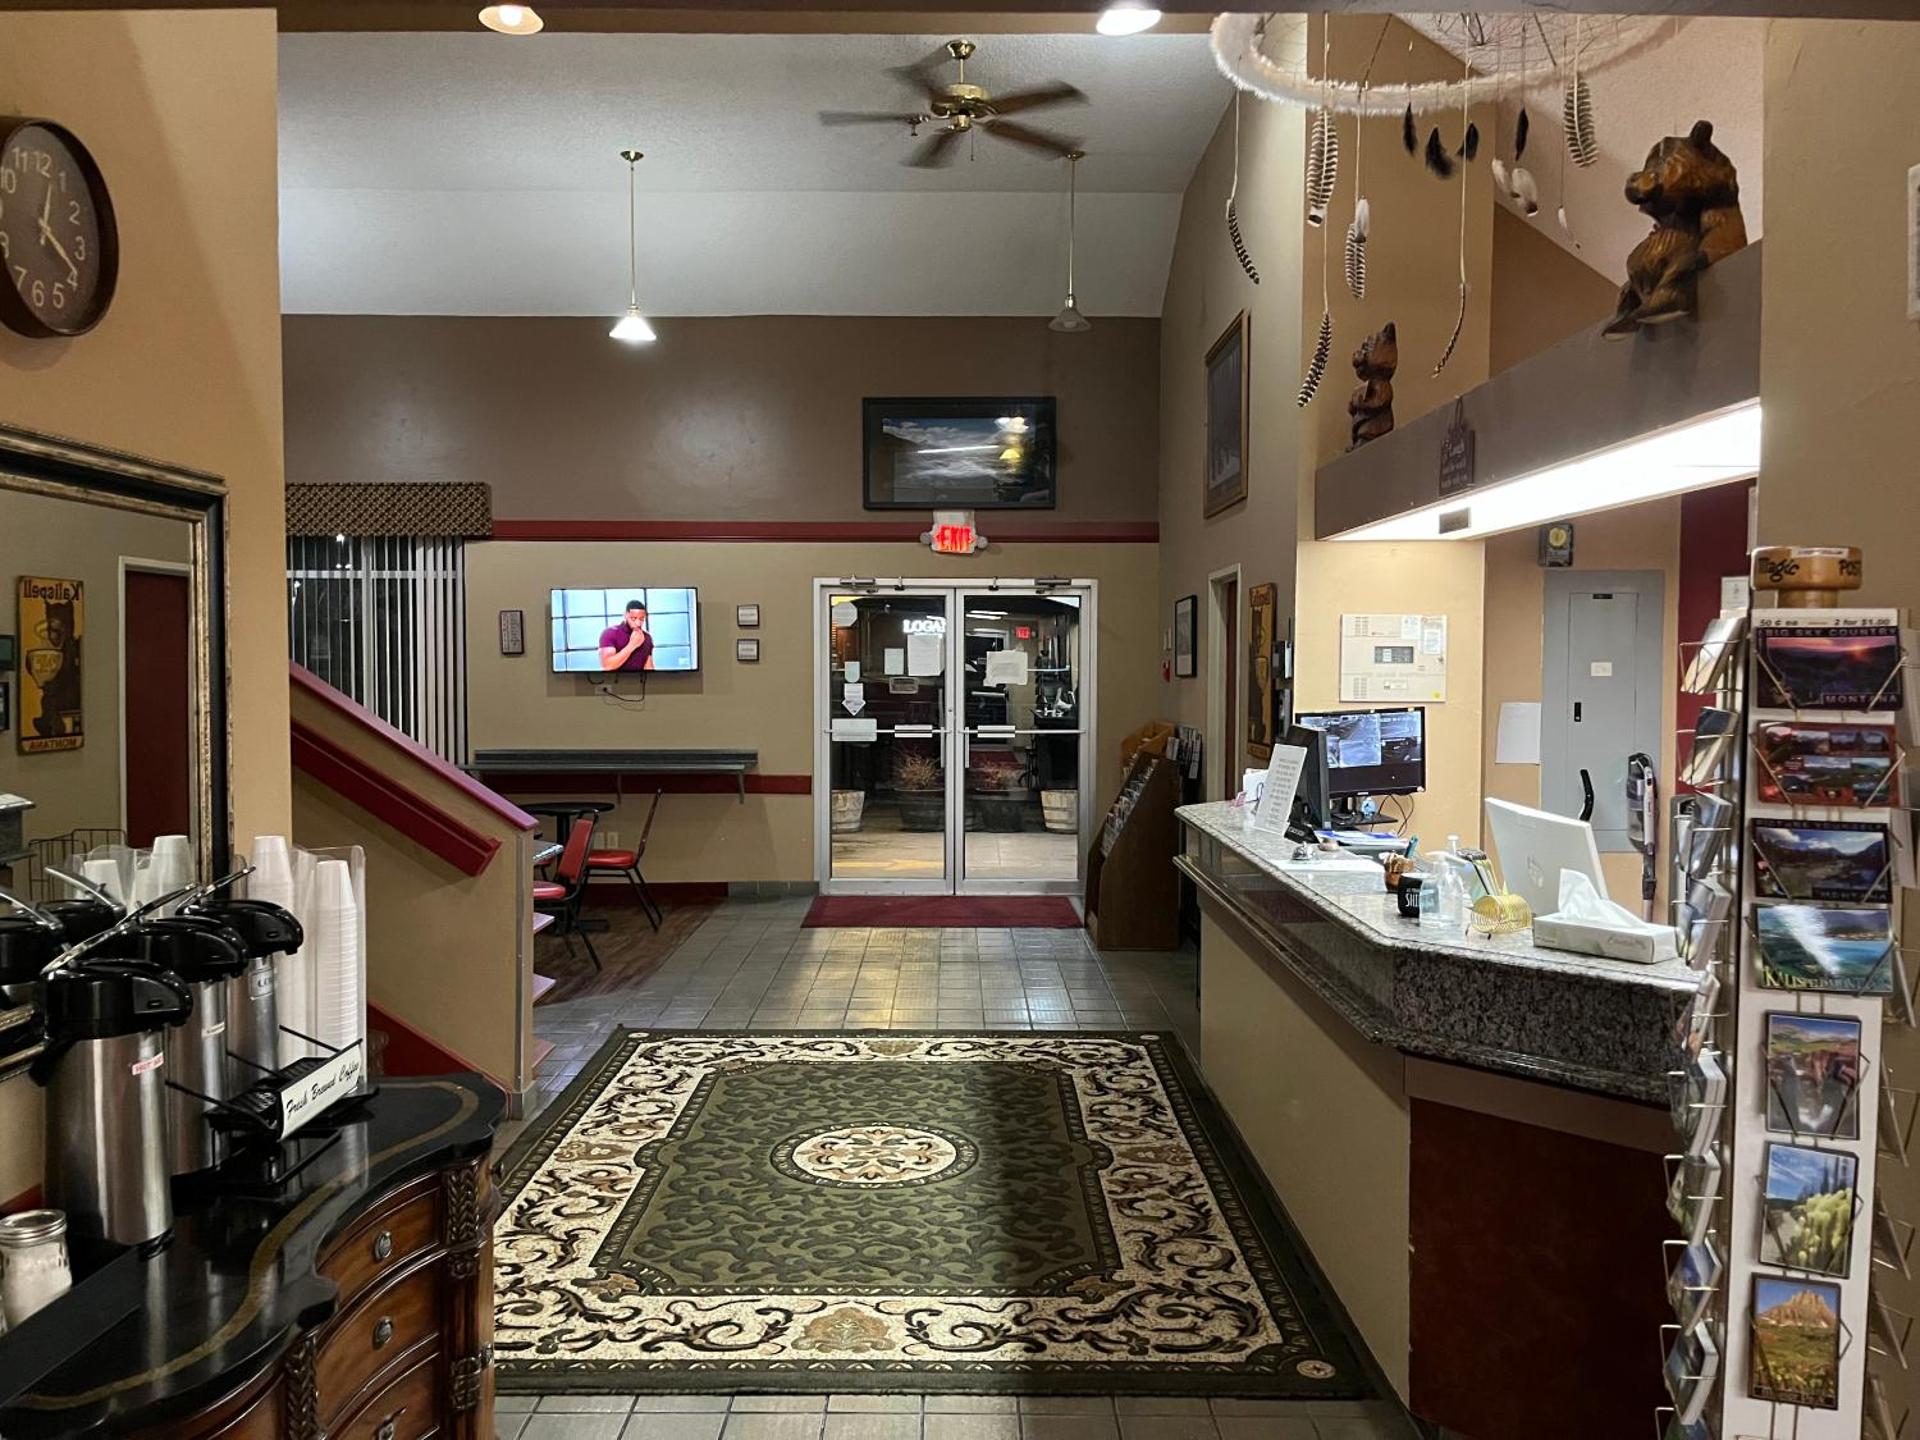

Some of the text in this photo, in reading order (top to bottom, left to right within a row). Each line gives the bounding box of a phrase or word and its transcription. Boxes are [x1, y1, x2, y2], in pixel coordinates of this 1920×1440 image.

[12, 147, 28, 173] 11
[33, 151, 51, 177] 12
[59, 171, 66, 192] 1
[69, 201, 80, 225] 2
[74, 236, 85, 261] 3
[14, 265, 27, 291] 7
[32, 280, 44, 306] 6
[53, 283, 64, 308] 5
[940, 526, 971, 550] EXIT
[1828, 628, 1897, 636] COUNTRY
[286, 1088, 308, 1119] Fresh
[338, 1061, 359, 1083] Coffee
